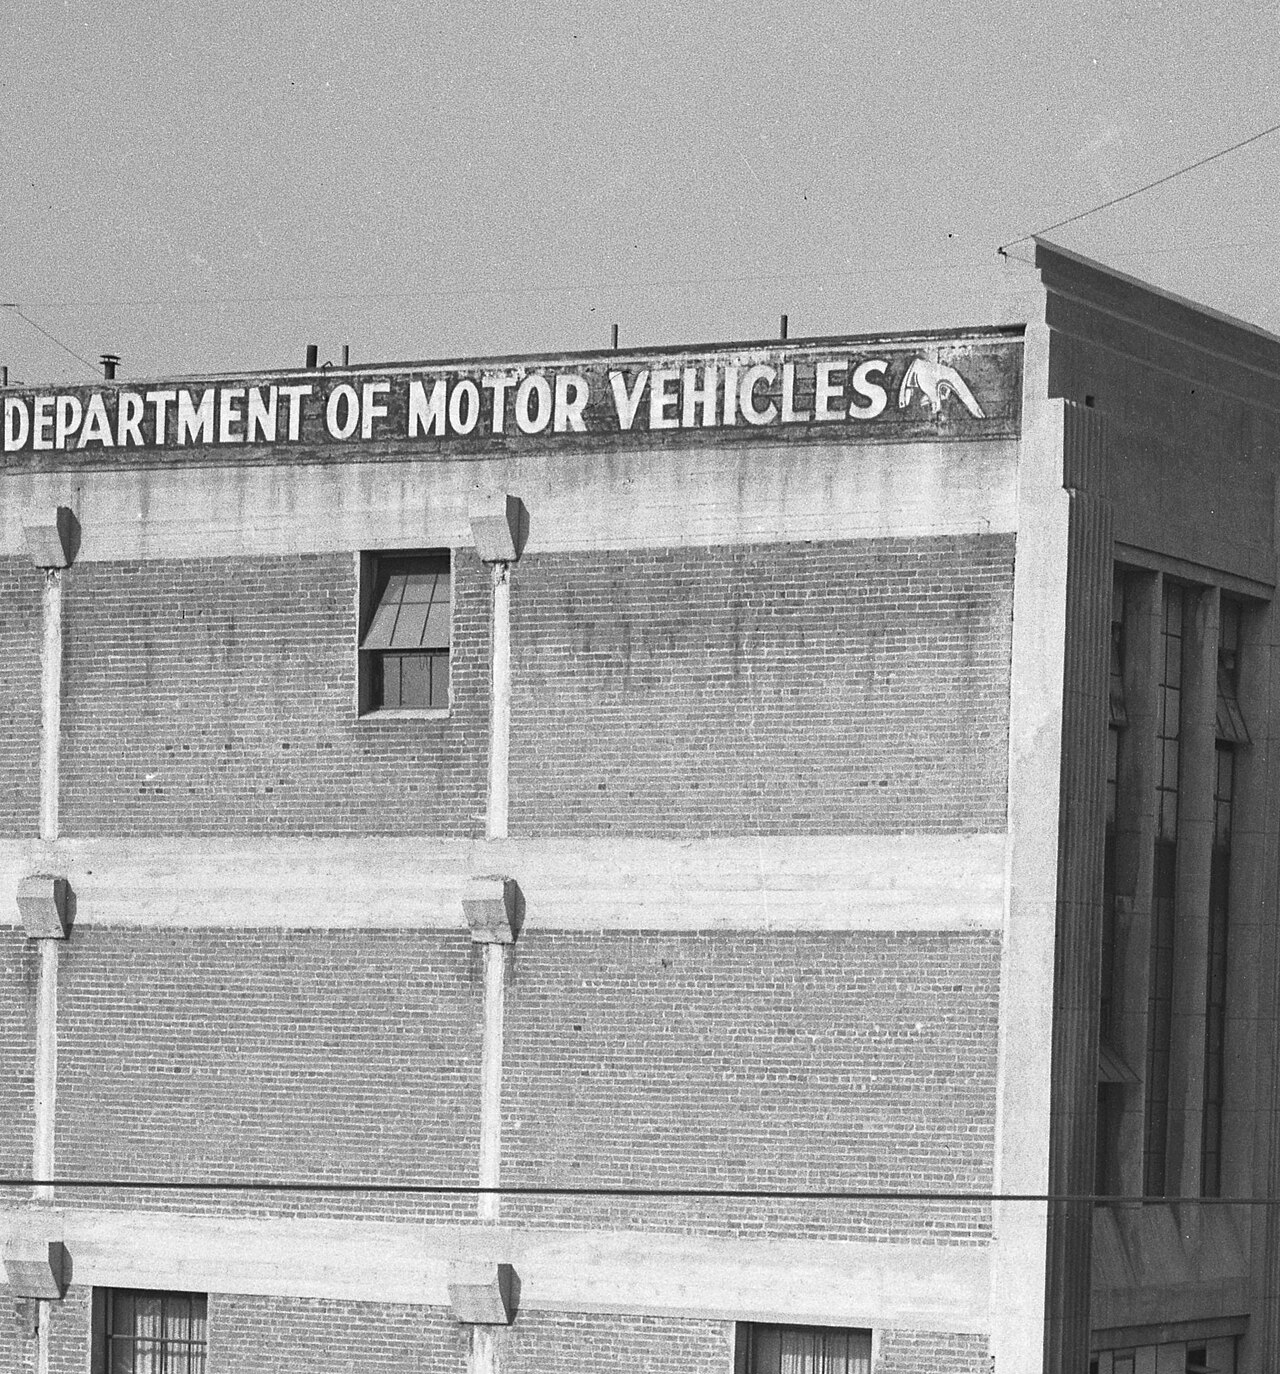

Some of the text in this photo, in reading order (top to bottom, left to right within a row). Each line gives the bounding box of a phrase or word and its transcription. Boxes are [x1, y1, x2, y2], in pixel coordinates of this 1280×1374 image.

[3, 359, 889, 452] DEPARTMENT OF MOTOR VEHICLES
